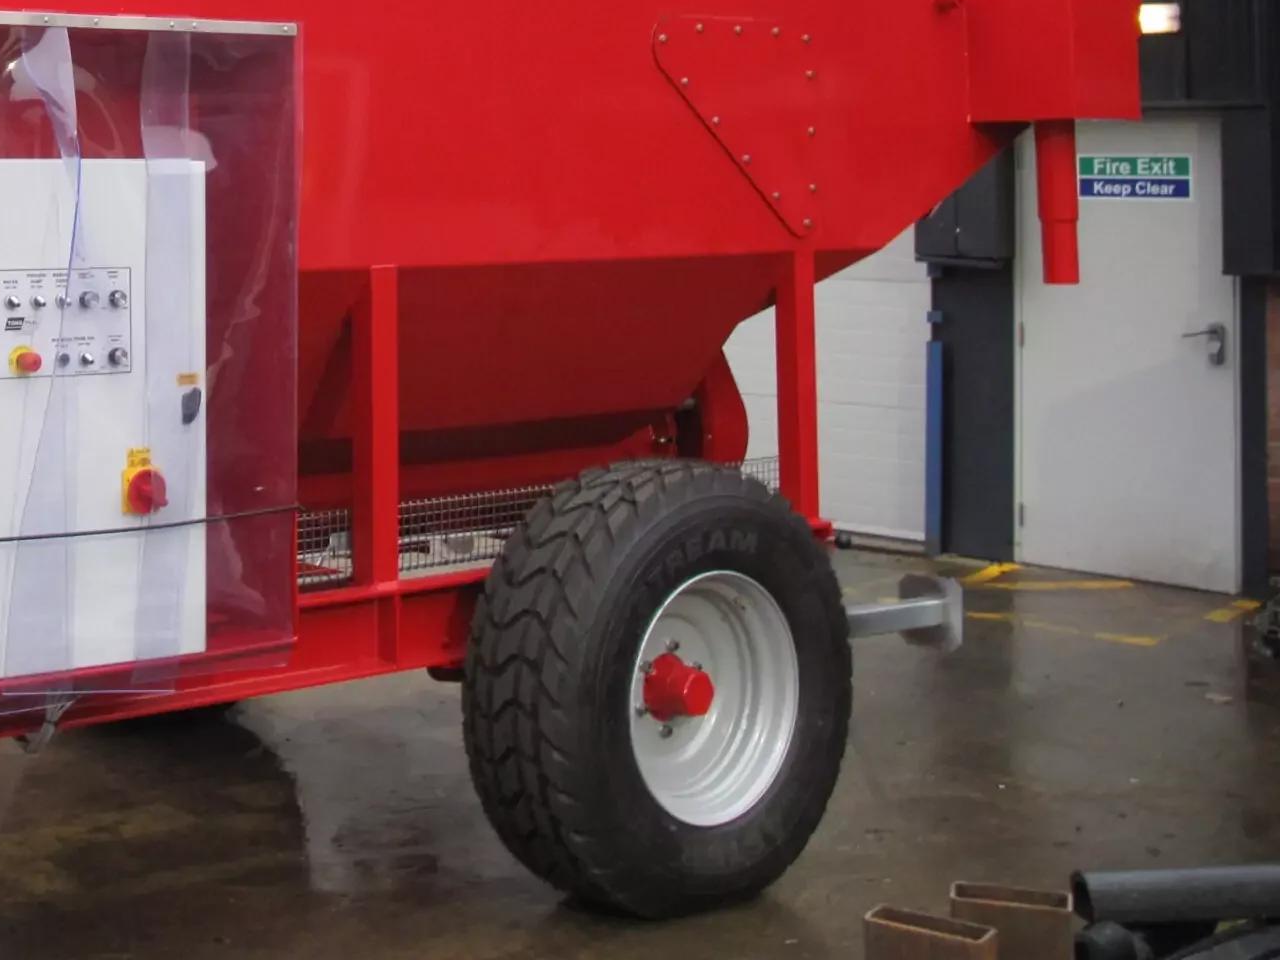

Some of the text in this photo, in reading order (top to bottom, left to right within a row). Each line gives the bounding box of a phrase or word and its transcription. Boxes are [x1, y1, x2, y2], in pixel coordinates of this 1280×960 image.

[1093, 158, 1176, 175] Fire Exit
[1093, 181, 1175, 197] Keep Clear
